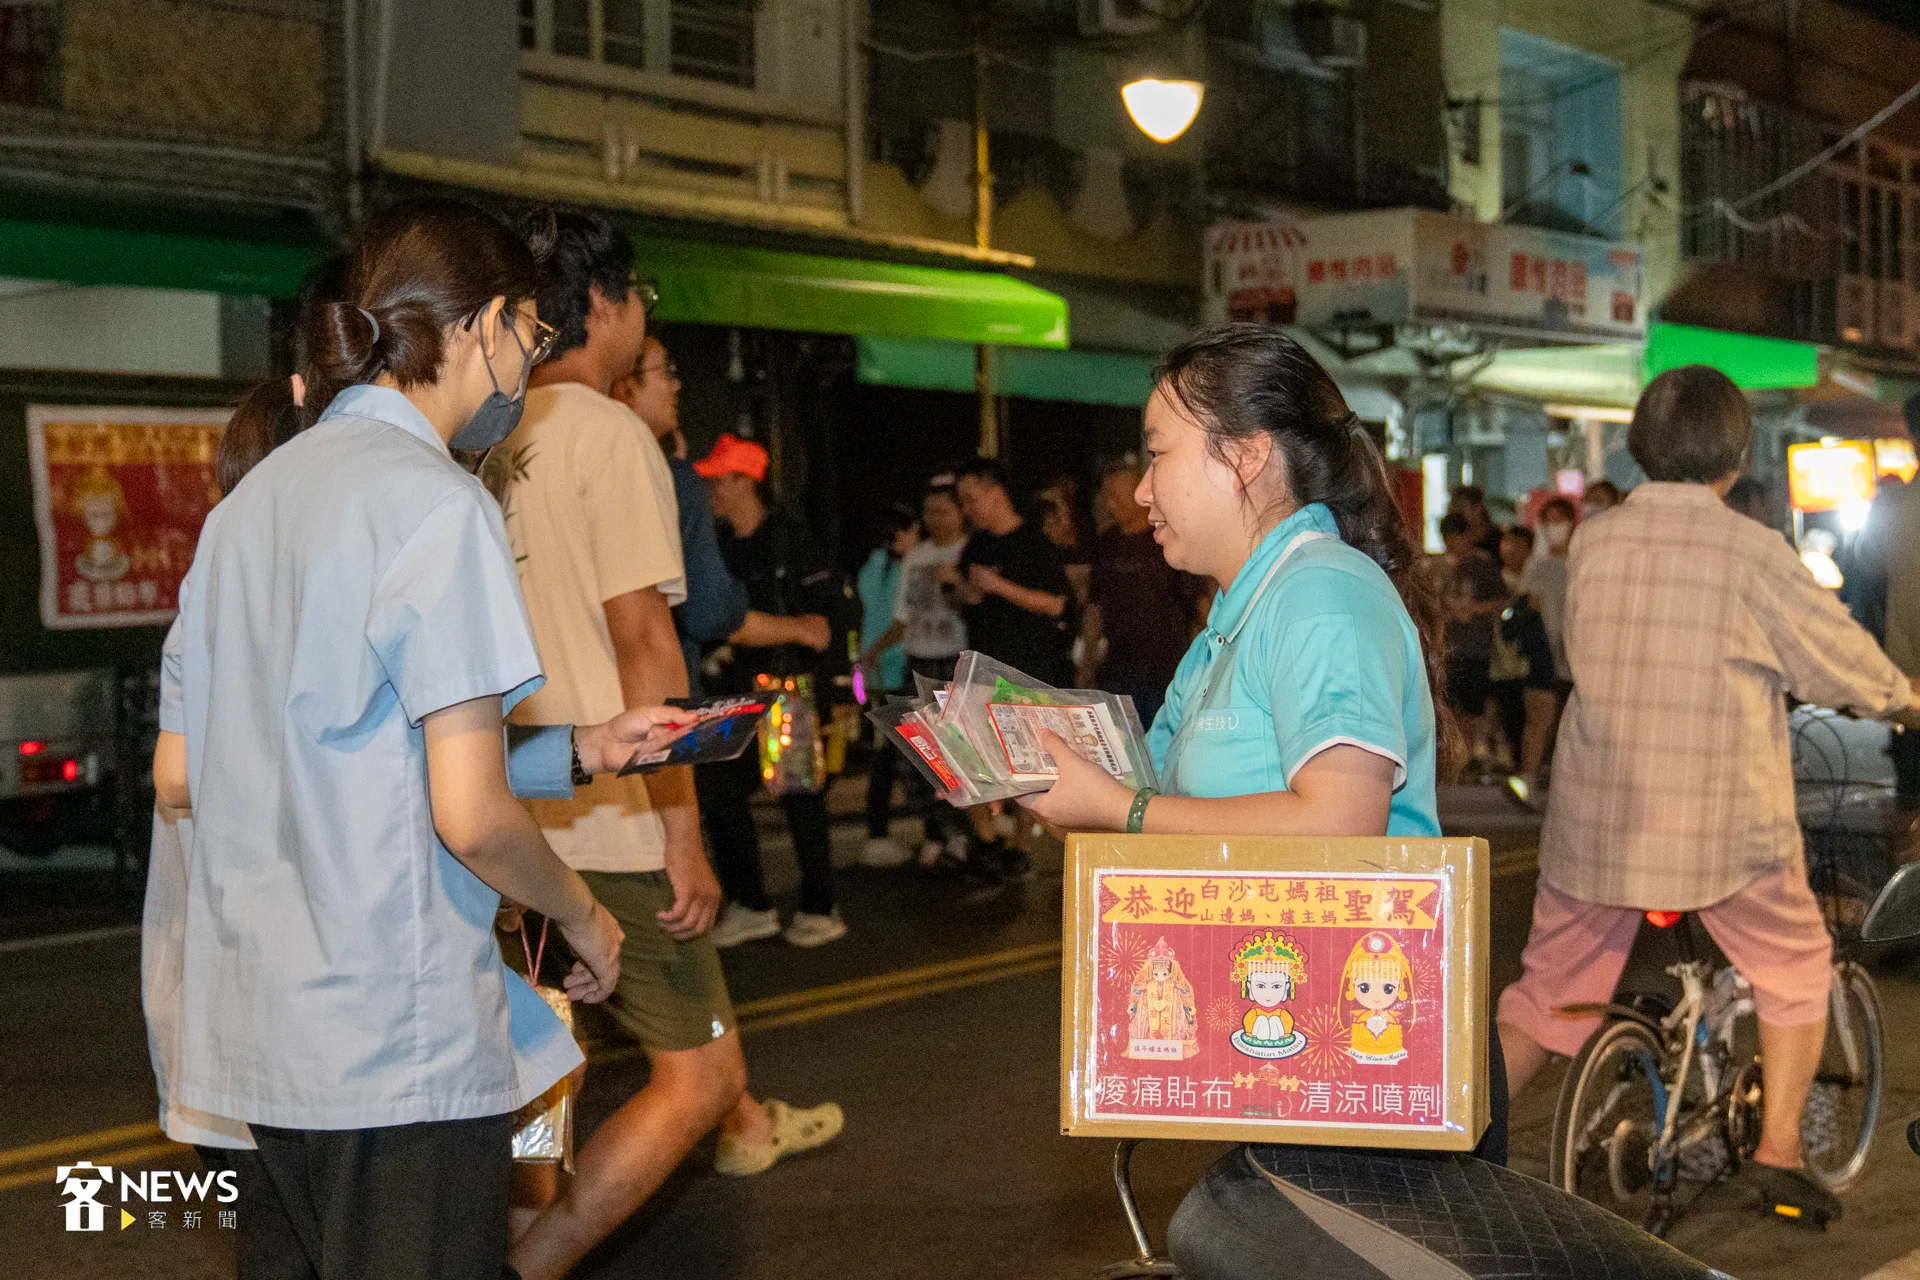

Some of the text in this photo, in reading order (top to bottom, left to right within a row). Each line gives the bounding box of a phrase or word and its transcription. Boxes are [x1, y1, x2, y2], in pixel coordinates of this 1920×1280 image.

[1121, 878, 1416, 926] 恭迎 白沙屯媽祖 聖駕
[1200, 907, 1338, 925] 山邊媽、爐主媽
[1233, 1036, 1303, 1058] Baishatun Matsu
[1098, 1073, 1234, 1110] 痠痛貼布
[1300, 1080, 1441, 1118] 清涼噴劑
